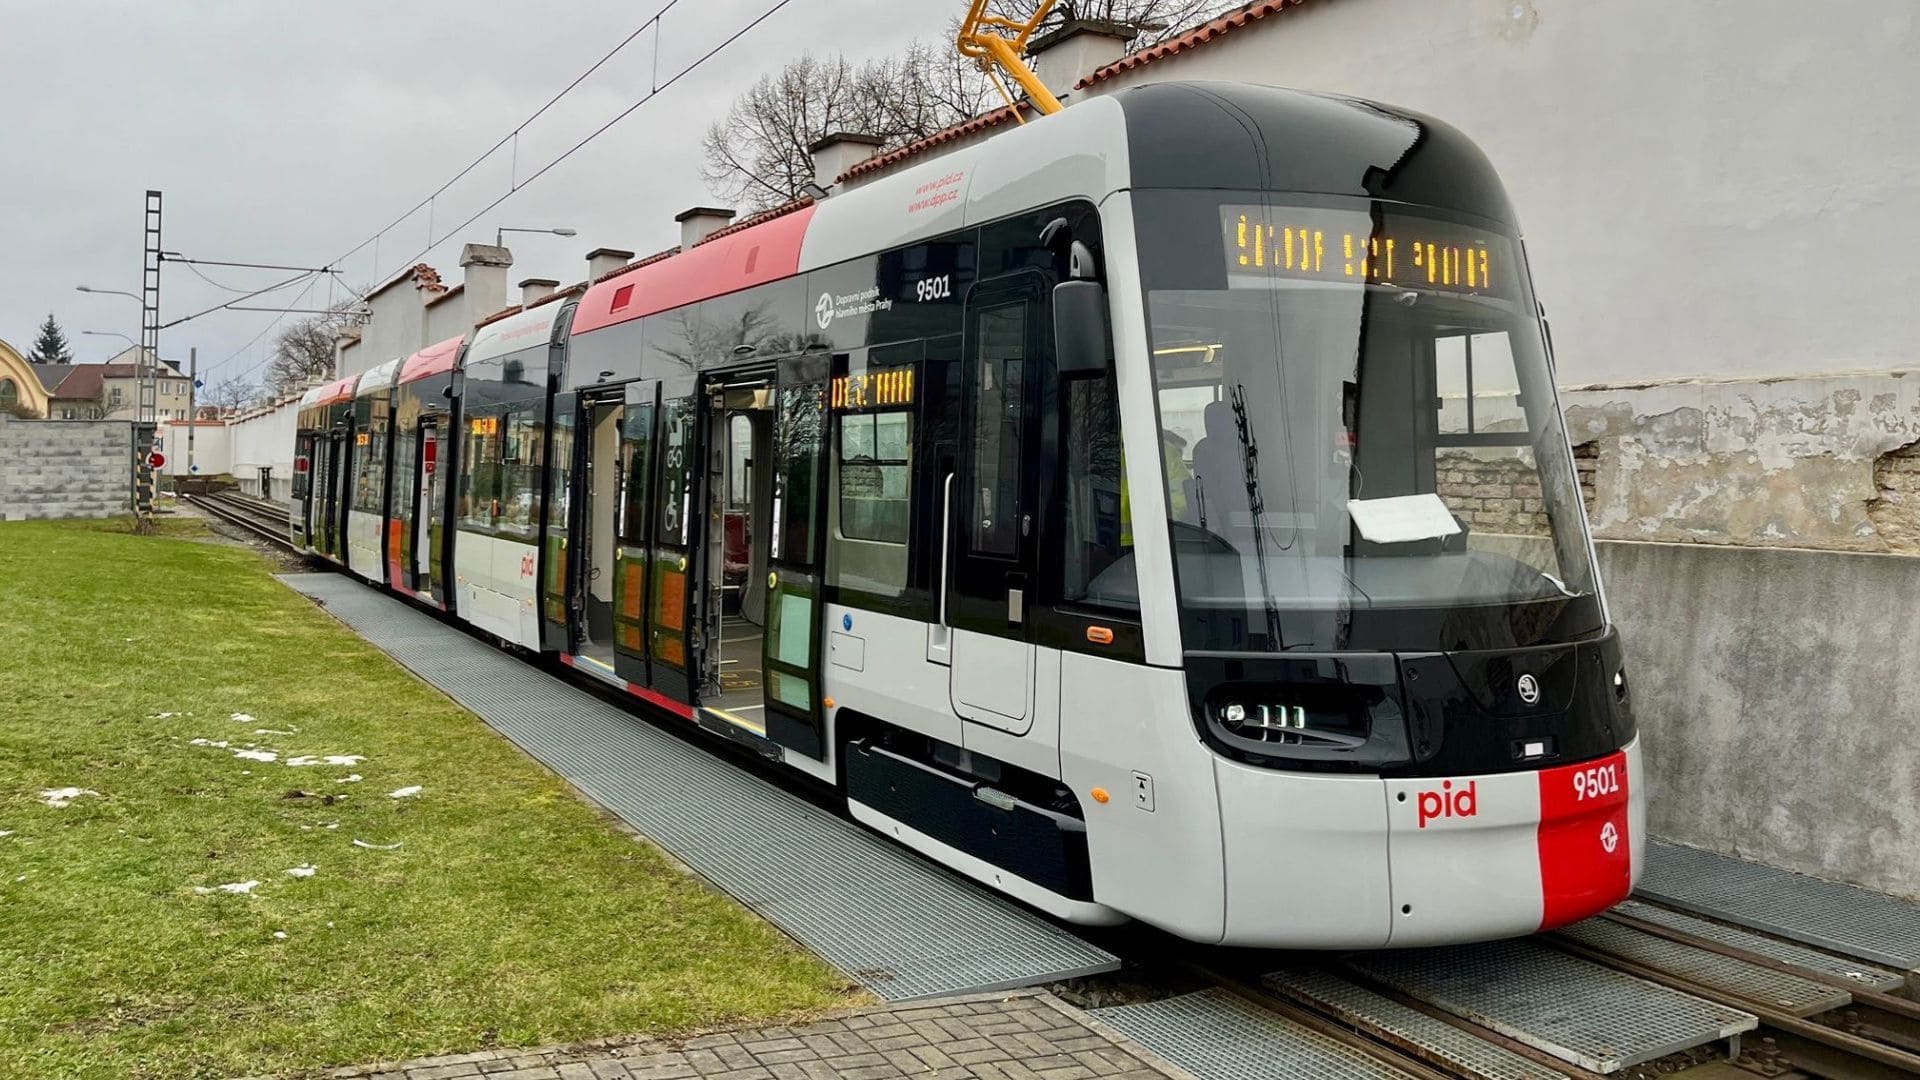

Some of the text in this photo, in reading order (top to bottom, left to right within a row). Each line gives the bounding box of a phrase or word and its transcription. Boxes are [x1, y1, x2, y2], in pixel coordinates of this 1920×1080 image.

[915, 171, 964, 195] www.pid.cz
[908, 189, 958, 213] www.dpp.cz
[836, 290, 860, 306] Dopravní
[917, 274, 951, 302] 9501
[875, 298, 892, 311] Prahy
[520, 551, 534, 579] pid
[1573, 764, 1619, 801] 9501
[1417, 779, 1477, 828] pid
